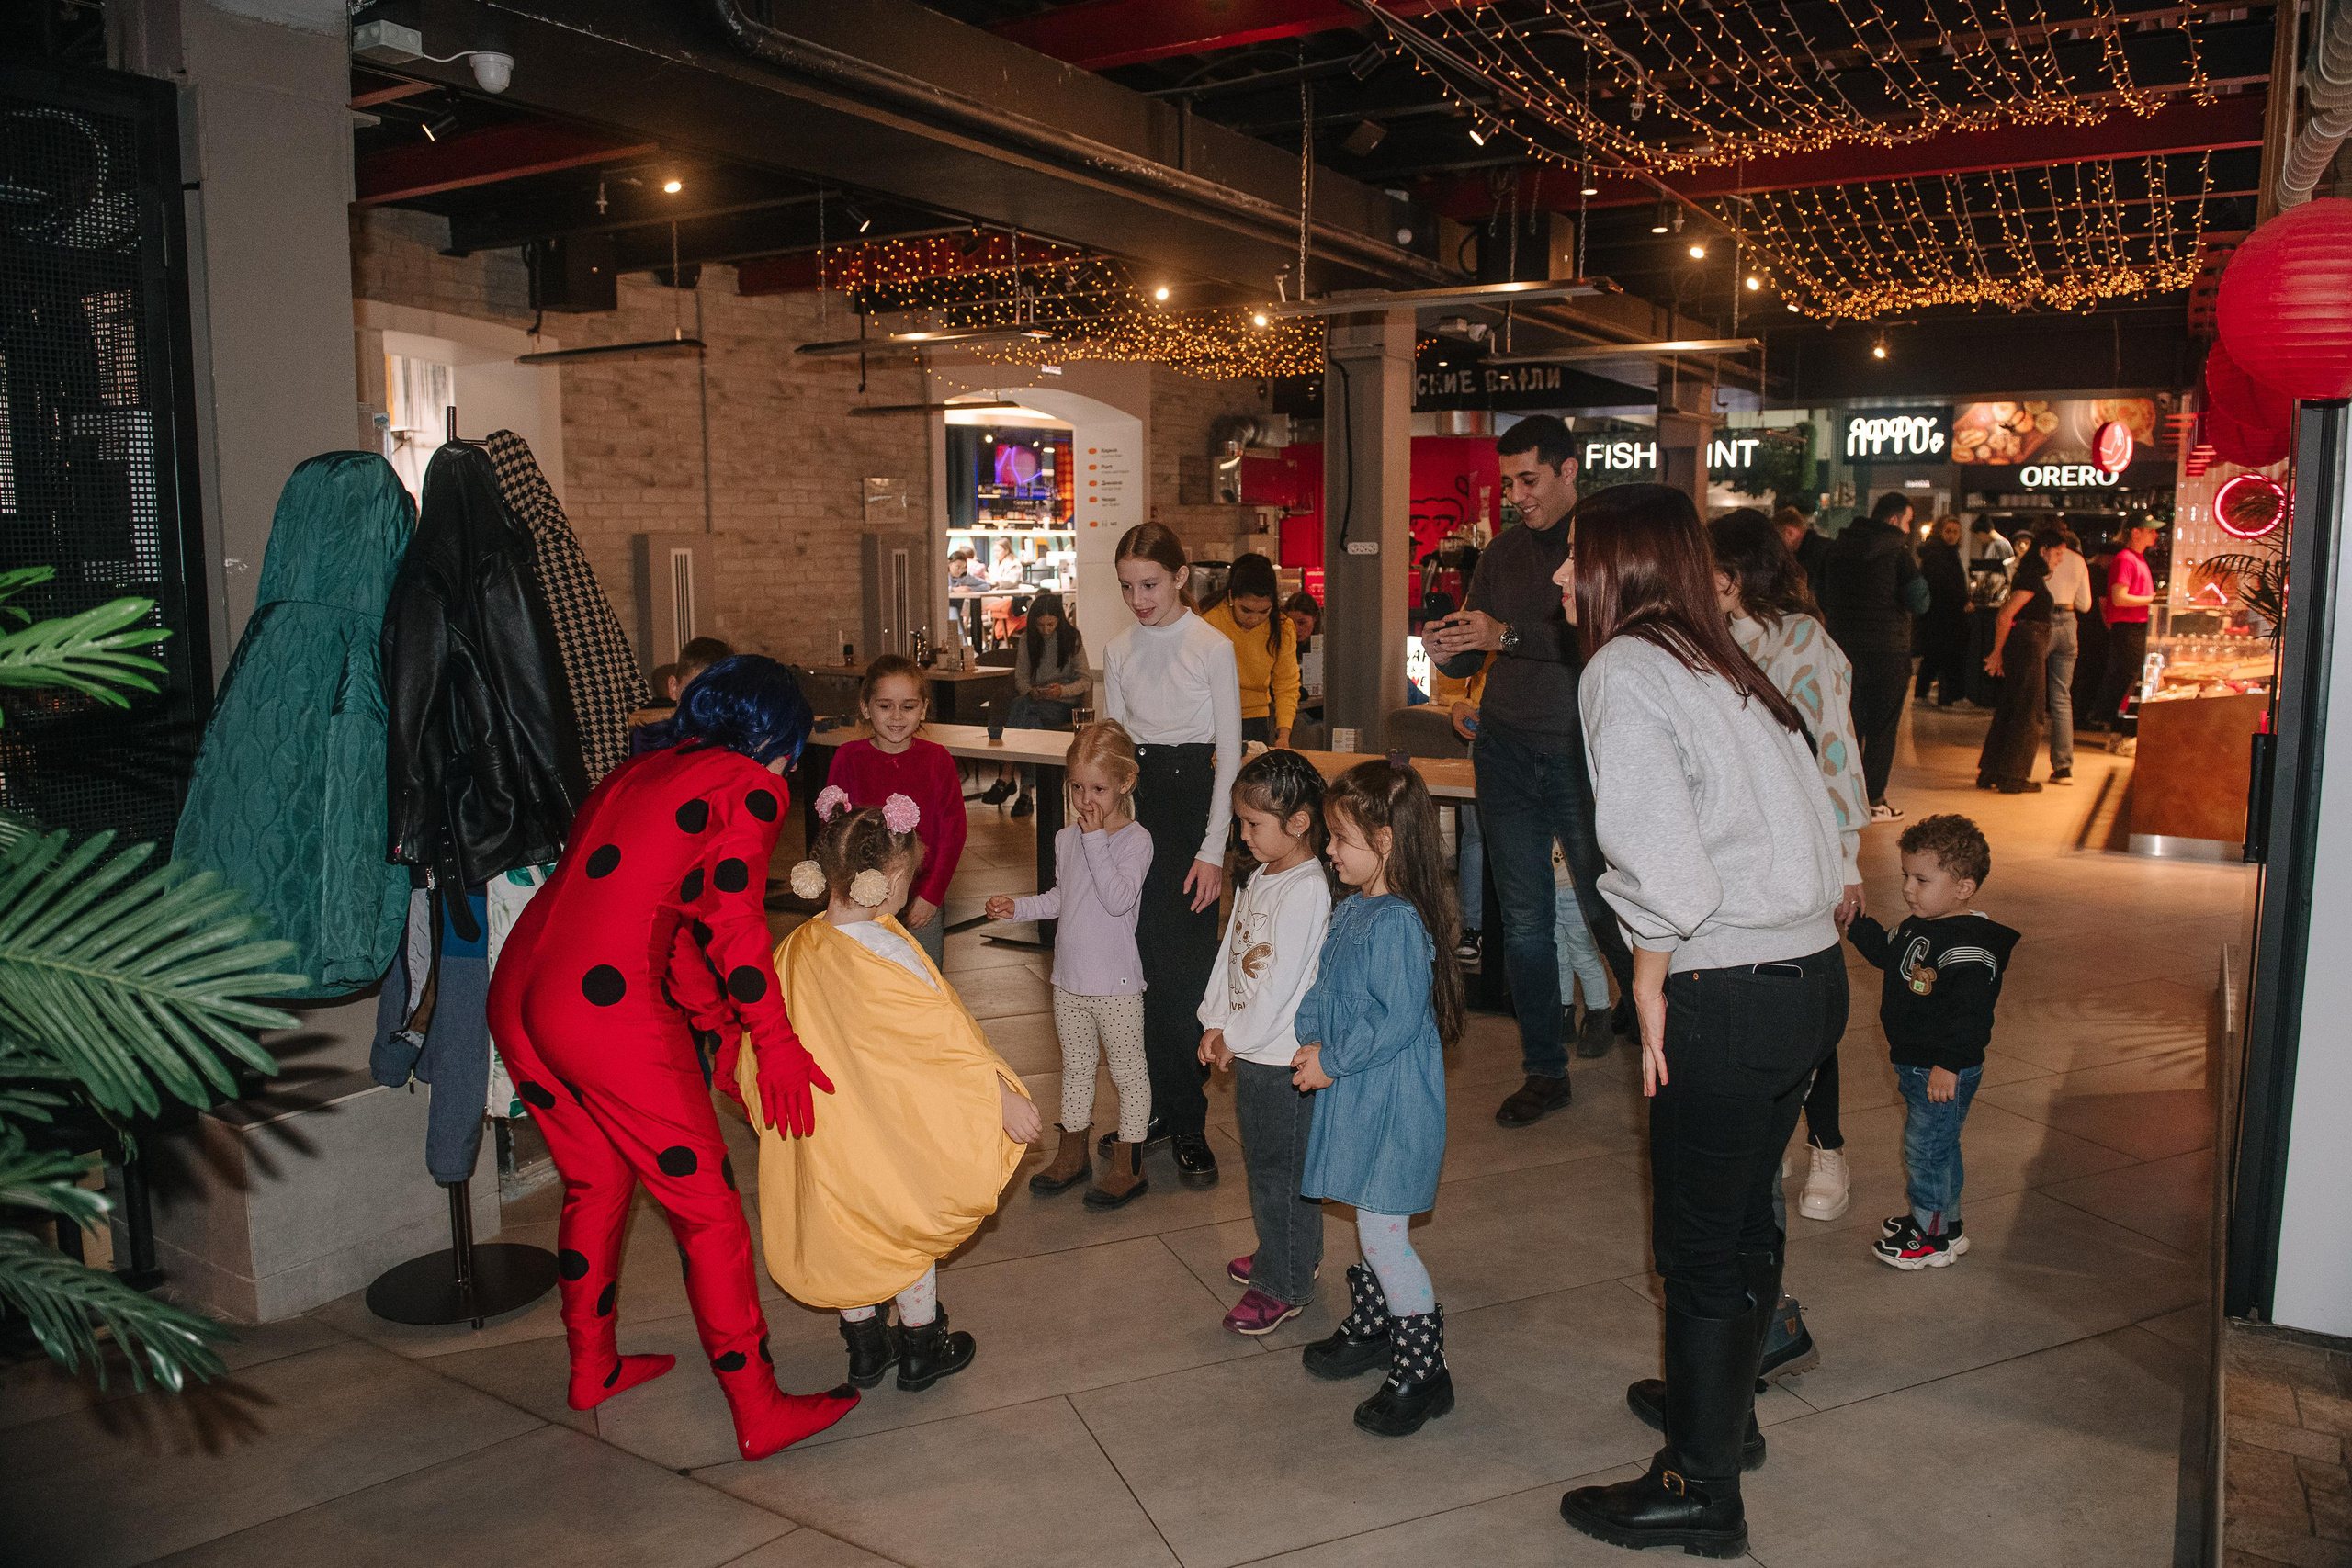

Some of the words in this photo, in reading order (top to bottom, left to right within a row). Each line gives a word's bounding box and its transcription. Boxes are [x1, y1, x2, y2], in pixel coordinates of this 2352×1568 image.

[1416, 369, 1476, 396] СКИЕ
[1484, 367, 1562, 393] ВАФЛИ
[1585, 441, 1657, 470] FISH
[1706, 439, 1760, 468] INT
[2019, 465, 2120, 487] ORERO
